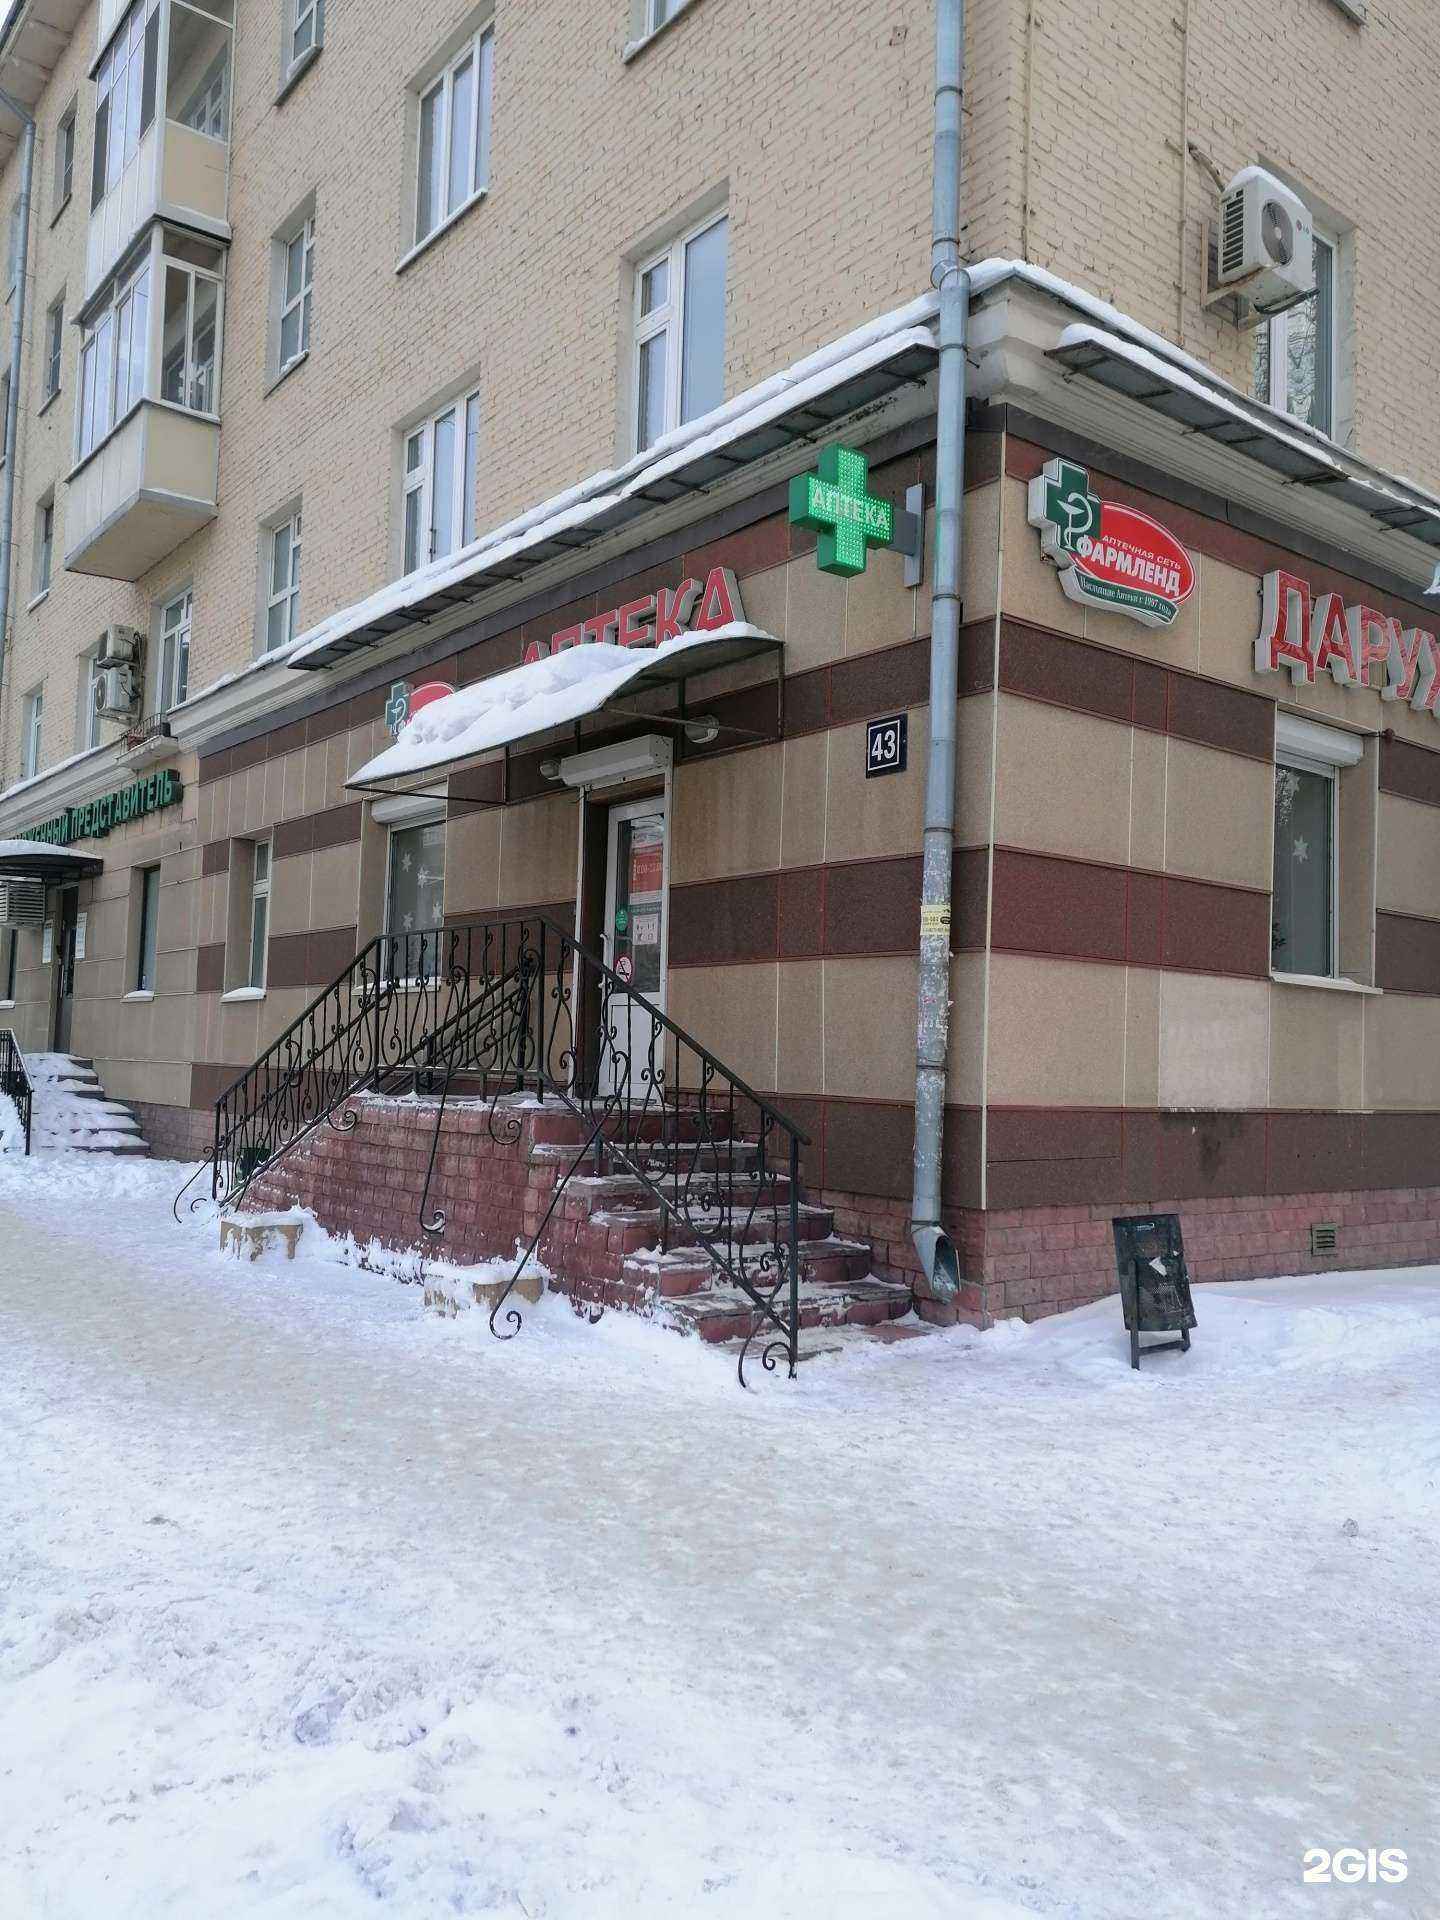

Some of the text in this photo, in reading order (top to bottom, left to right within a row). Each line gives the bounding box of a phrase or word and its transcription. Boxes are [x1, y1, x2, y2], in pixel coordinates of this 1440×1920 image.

[812, 486, 889, 530] АПТЕКА
[1076, 534, 1181, 597] ФАРМЛЕНД
[1102, 535, 1181, 570] АПТЕЧНАЯ СЕТЬ
[872, 729, 896, 761] 43
[72, 770, 176, 839] ПРЕДСТАВИТЕЛЬ
